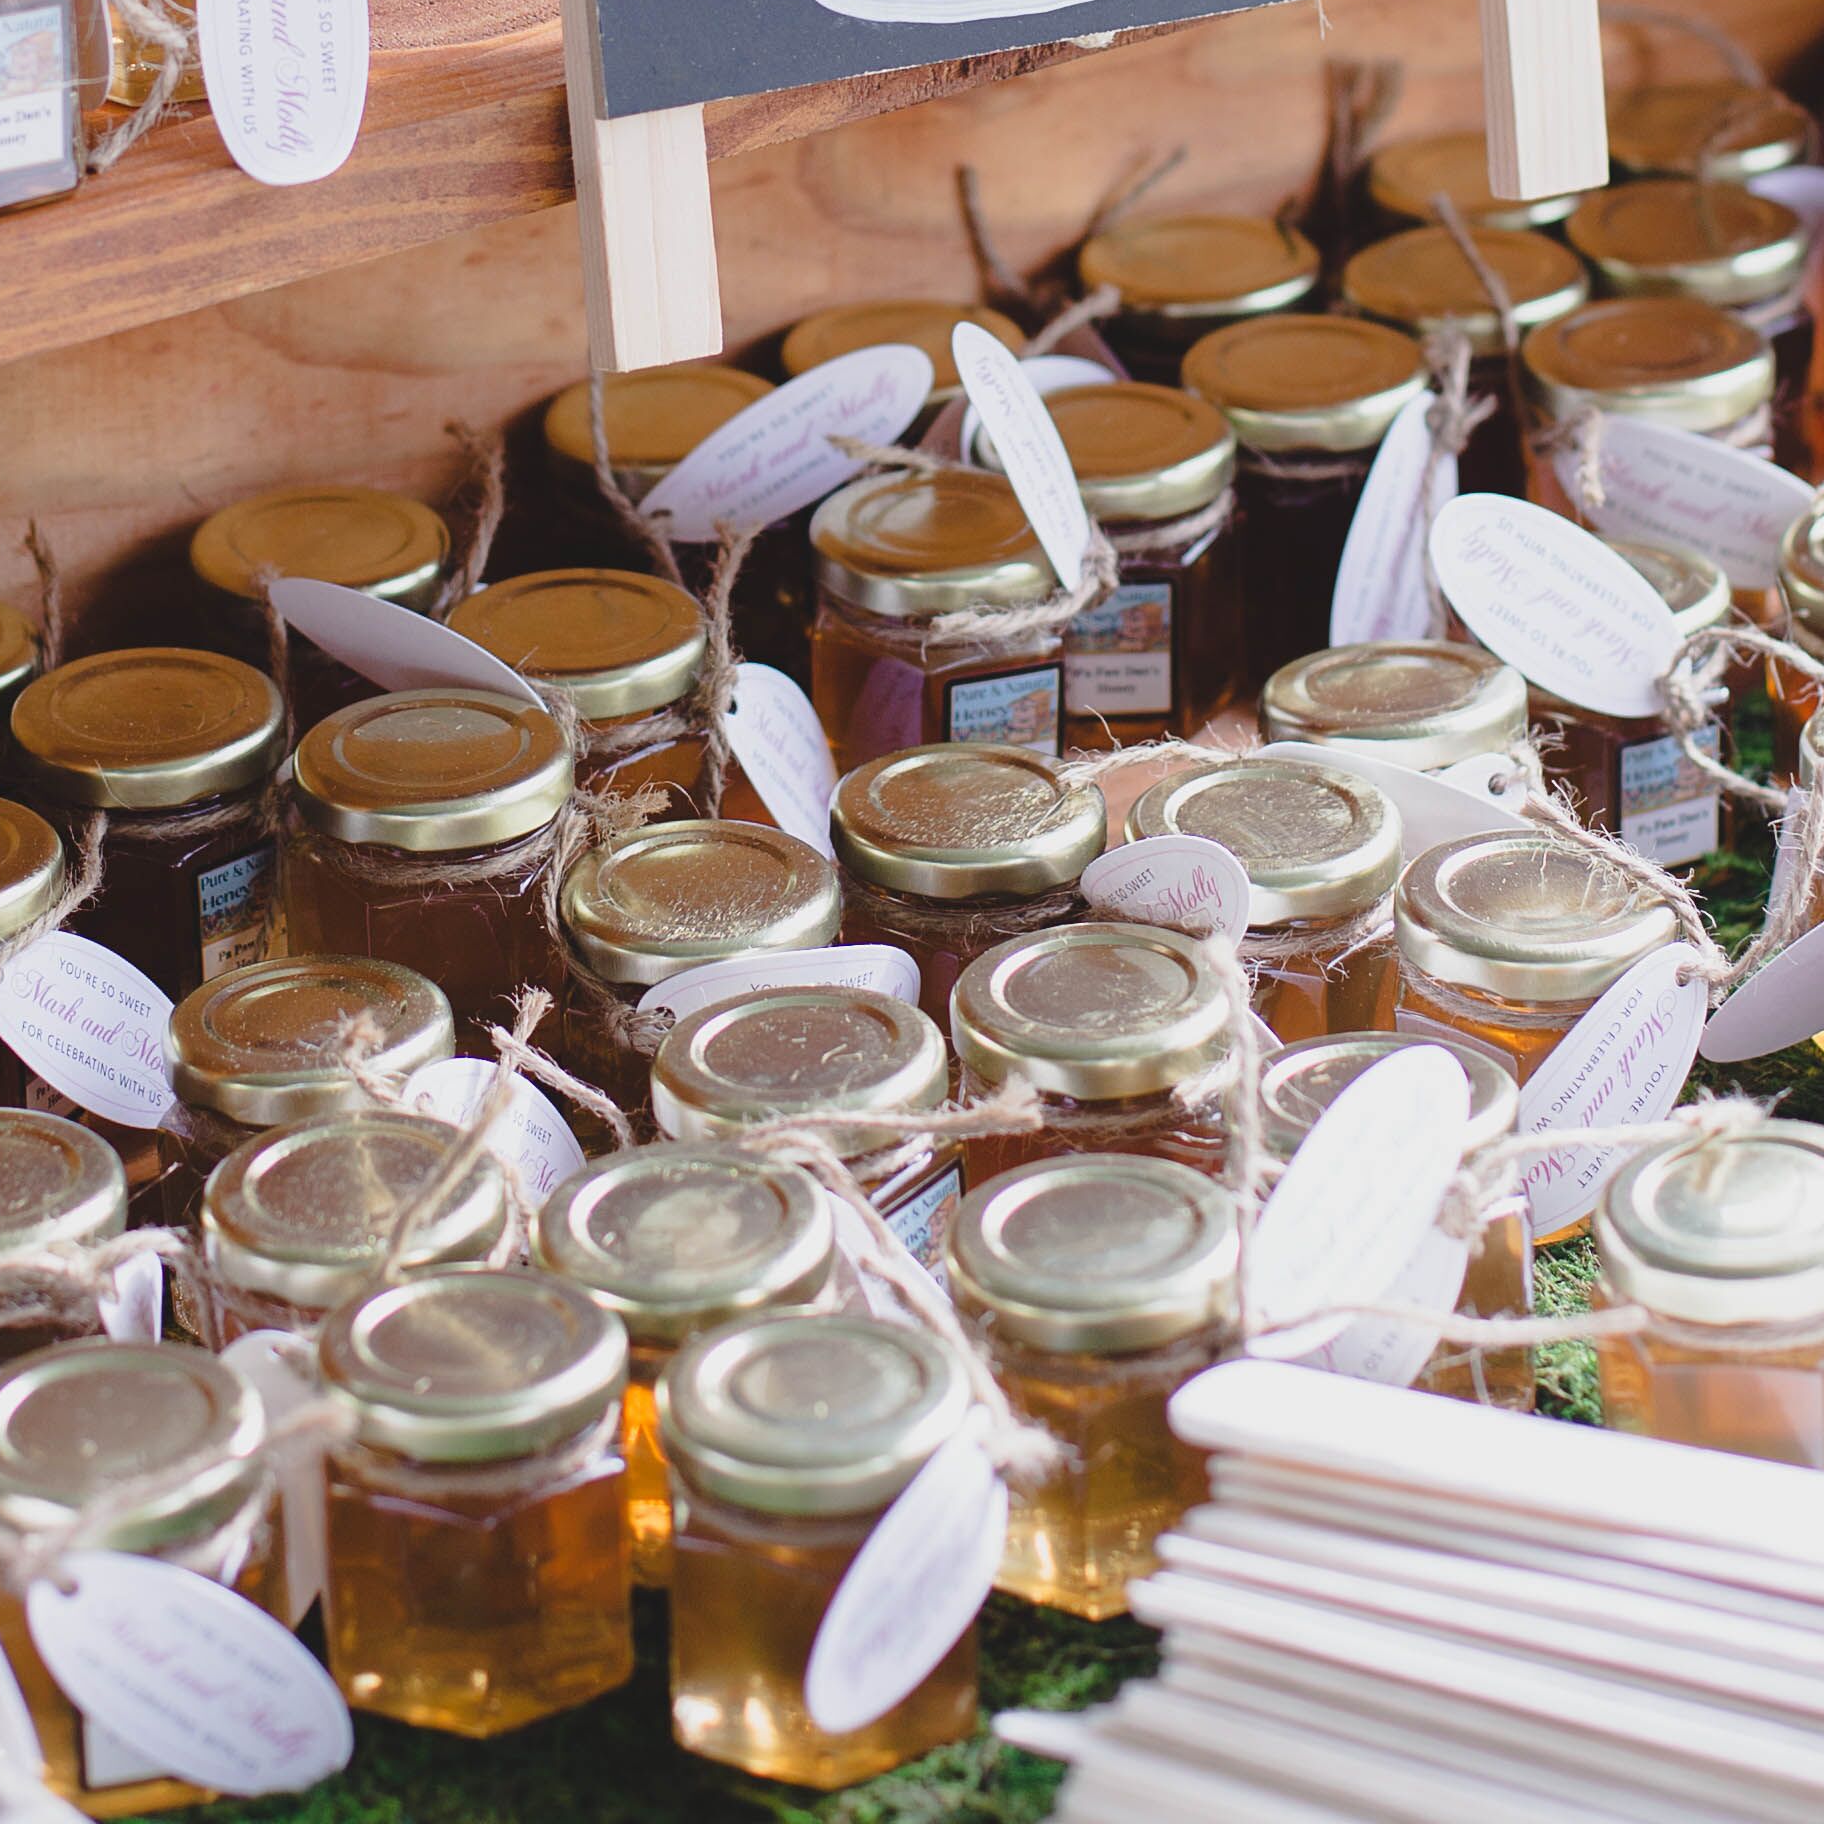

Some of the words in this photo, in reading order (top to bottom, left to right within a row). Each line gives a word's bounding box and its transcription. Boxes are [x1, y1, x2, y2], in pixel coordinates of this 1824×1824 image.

[319, 11, 333, 33] SO
[320, 41, 337, 95] SWEET
[241, 63, 255, 108] WITH
[265, 57, 314, 157] Molly
[243, 114, 258, 135] US
[769, 420, 814, 468] and
[1497, 516, 1512, 534] US
[1456, 525, 1524, 595] Molly
[1514, 530, 1547, 559] WITH
[1550, 553, 1628, 613] CELEBRATING
[1488, 602, 1527, 634] SWEET
[1528, 587, 1583, 618] and
[1530, 629, 1548, 647] SO
[1631, 611, 1657, 633] FOR
[1573, 617, 1650, 673] Mark
[955, 686, 988, 703] Pure
[954, 705, 1009, 723] Honey
[201, 871, 230, 891] Pure
[233, 864, 242, 877] &
[1126, 868, 1155, 895] SWEET
[1156, 865, 1223, 921] Molly
[218, 950, 232, 962] Pa
[59, 957, 97, 989] YOU'RE
[101, 980, 116, 998] SO
[119, 990, 151, 1019] SWEET
[1623, 987, 1644, 1020] FOR
[11, 970, 84, 1025] Mark
[80, 1017, 124, 1046] and
[1618, 989, 1676, 1089] Mark
[22, 1021, 43, 1042] FOR
[47, 1034, 116, 1081] CELEBRATING
[119, 1073, 145, 1097] WITH
[148, 1092, 162, 1107] US
[1552, 1022, 1622, 1115] CELEBRATING
[1631, 1063, 1670, 1115] YOU'RE
[526, 1120, 552, 1145] SWEET
